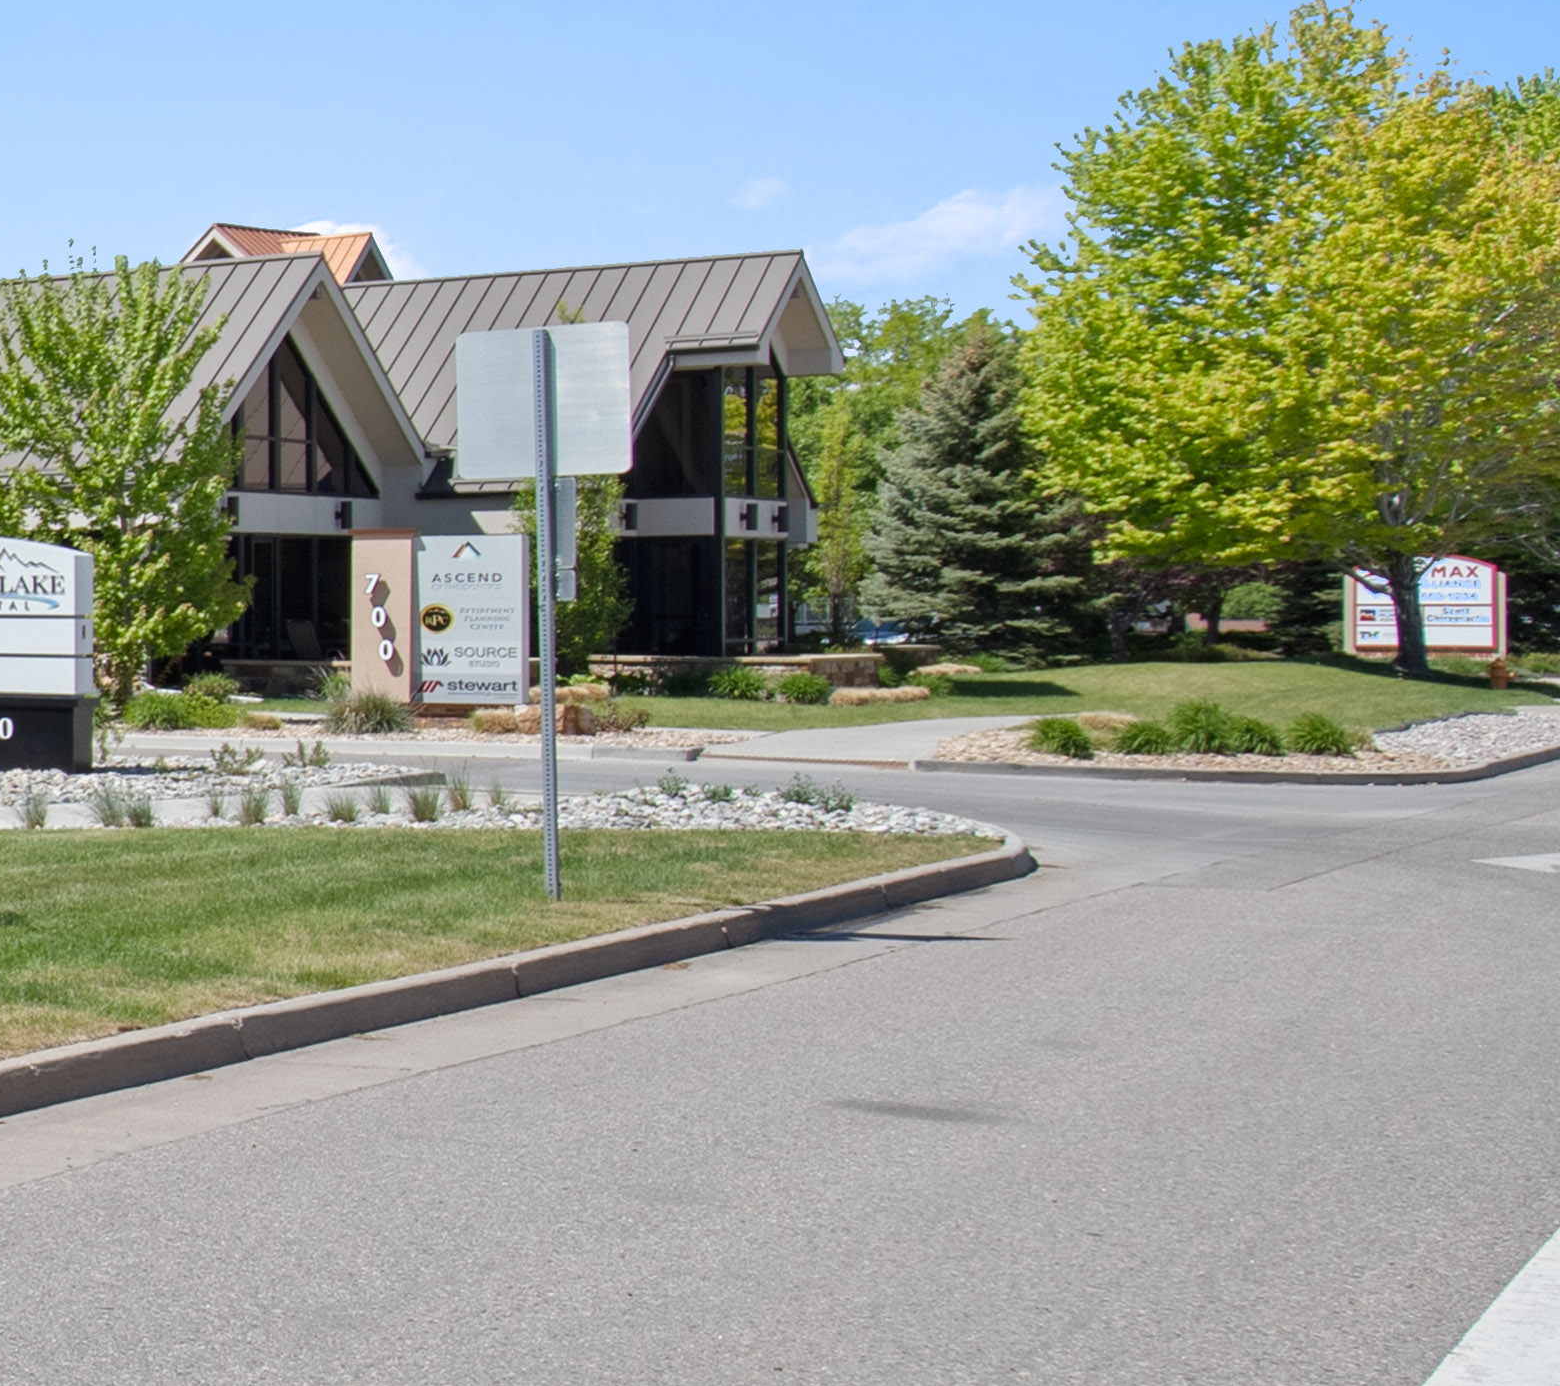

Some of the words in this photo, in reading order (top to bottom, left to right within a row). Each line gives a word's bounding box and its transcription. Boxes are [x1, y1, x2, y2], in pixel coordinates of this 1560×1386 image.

[0, 574, 66, 595] LAKE
[431, 572, 503, 584] ASCEND
[453, 646, 519, 659] SOURCE
[446, 678, 520, 692] stewart
